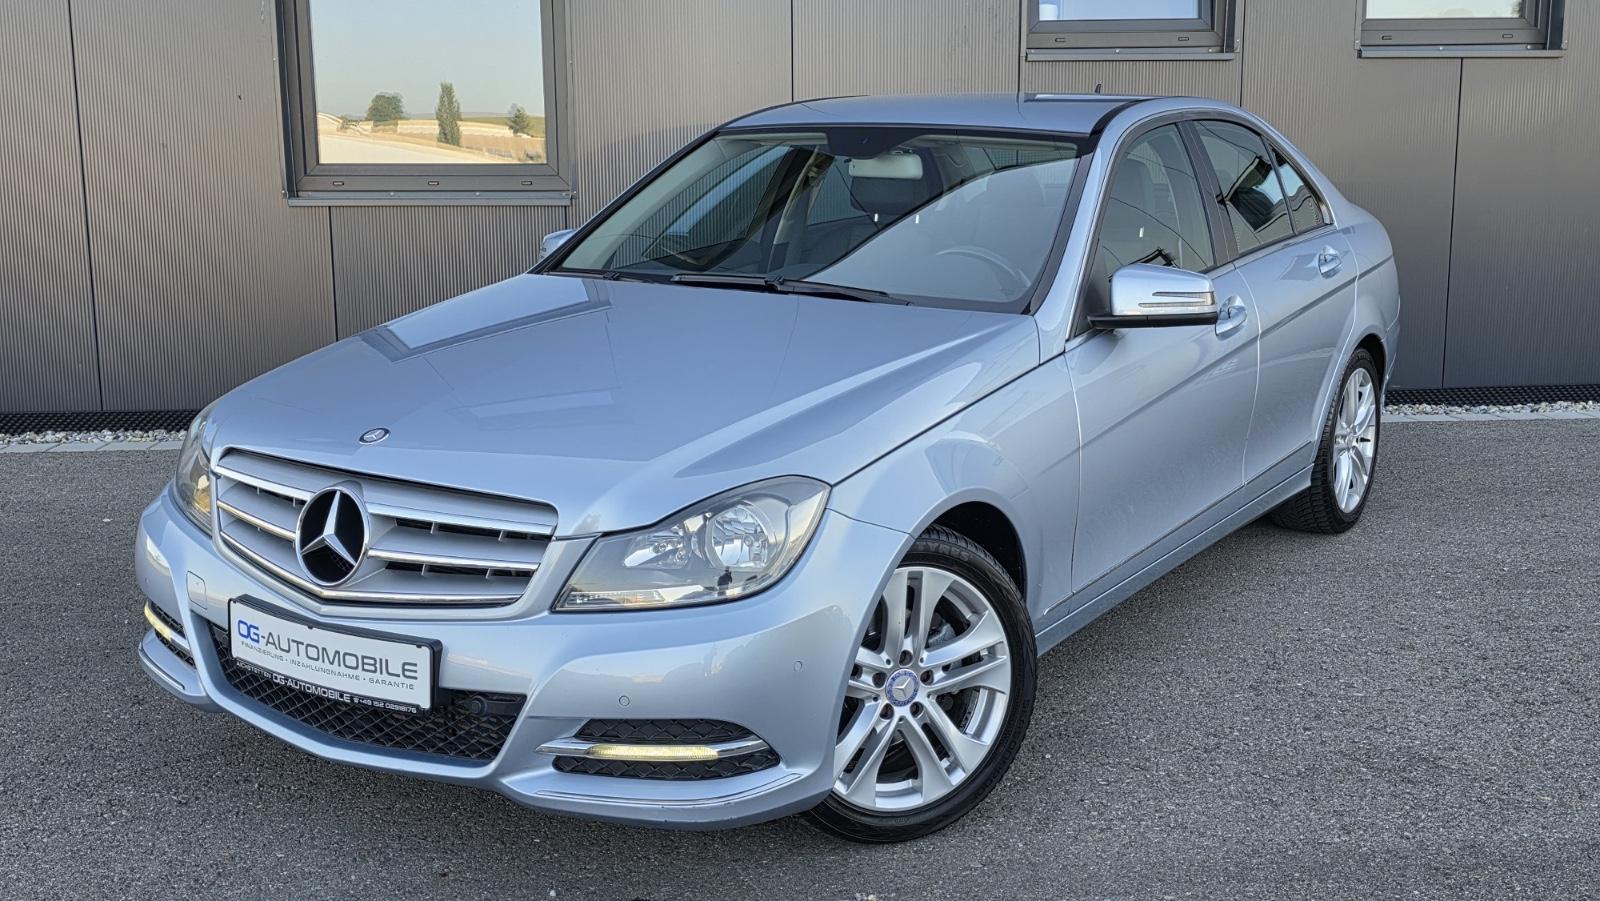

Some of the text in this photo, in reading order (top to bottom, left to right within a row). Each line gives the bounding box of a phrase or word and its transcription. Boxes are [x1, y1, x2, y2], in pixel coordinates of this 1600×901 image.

[237, 619, 418, 681] OG-AUTOMOBILE
[272, 673, 351, 704] OG-AUTOMOBILE
[368, 677, 415, 691] GARANTIE
